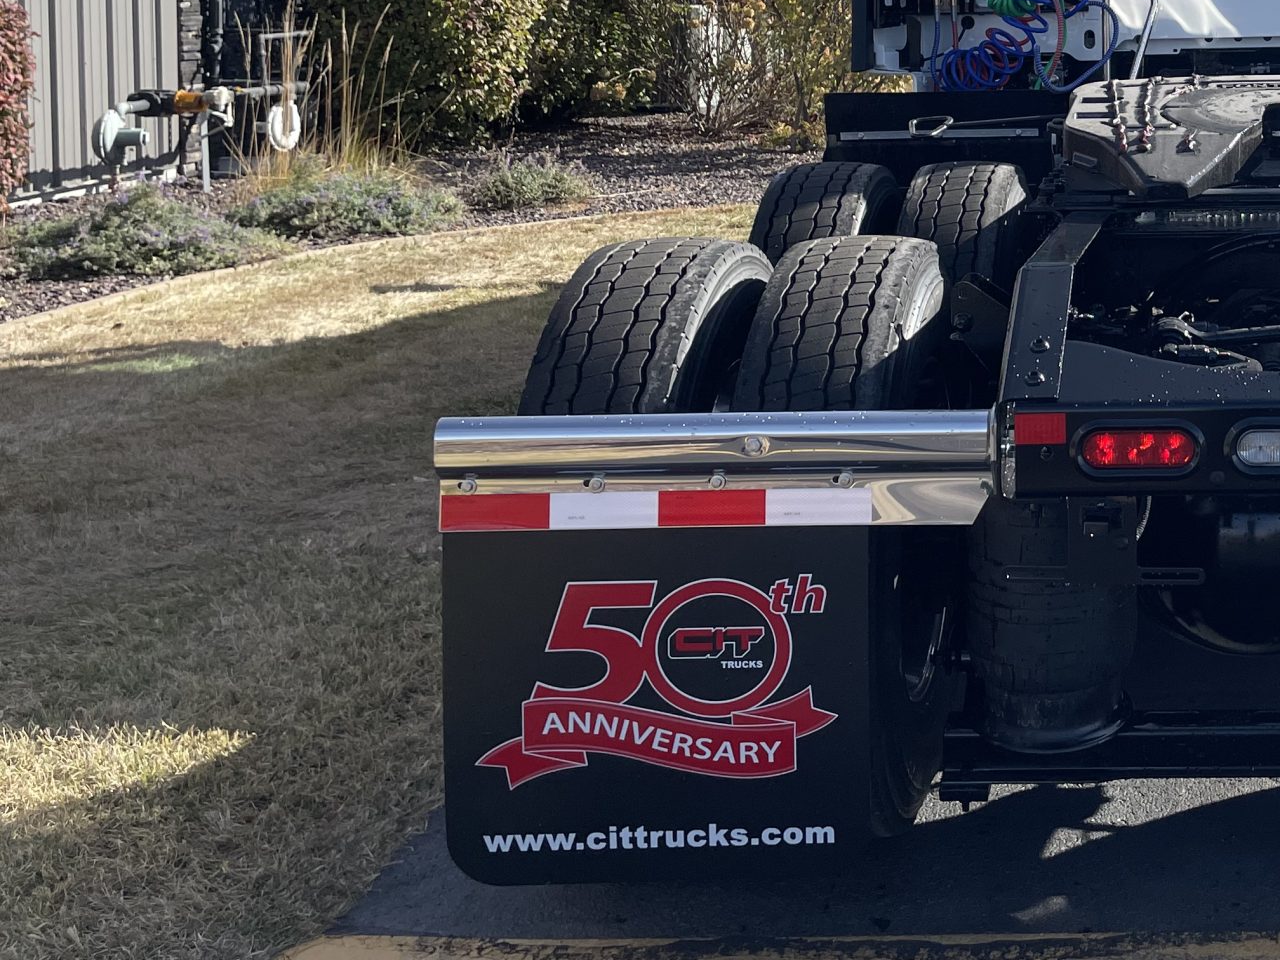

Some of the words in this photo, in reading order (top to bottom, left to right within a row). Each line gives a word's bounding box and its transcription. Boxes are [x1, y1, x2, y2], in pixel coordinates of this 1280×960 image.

[530, 573, 828, 718] 50th
[667, 626, 765, 659] CIT
[721, 660, 763, 669] TRUCKS
[541, 712, 782, 764] ANNIVERSARY
[482, 823, 836, 853] www.cittrucks.com
